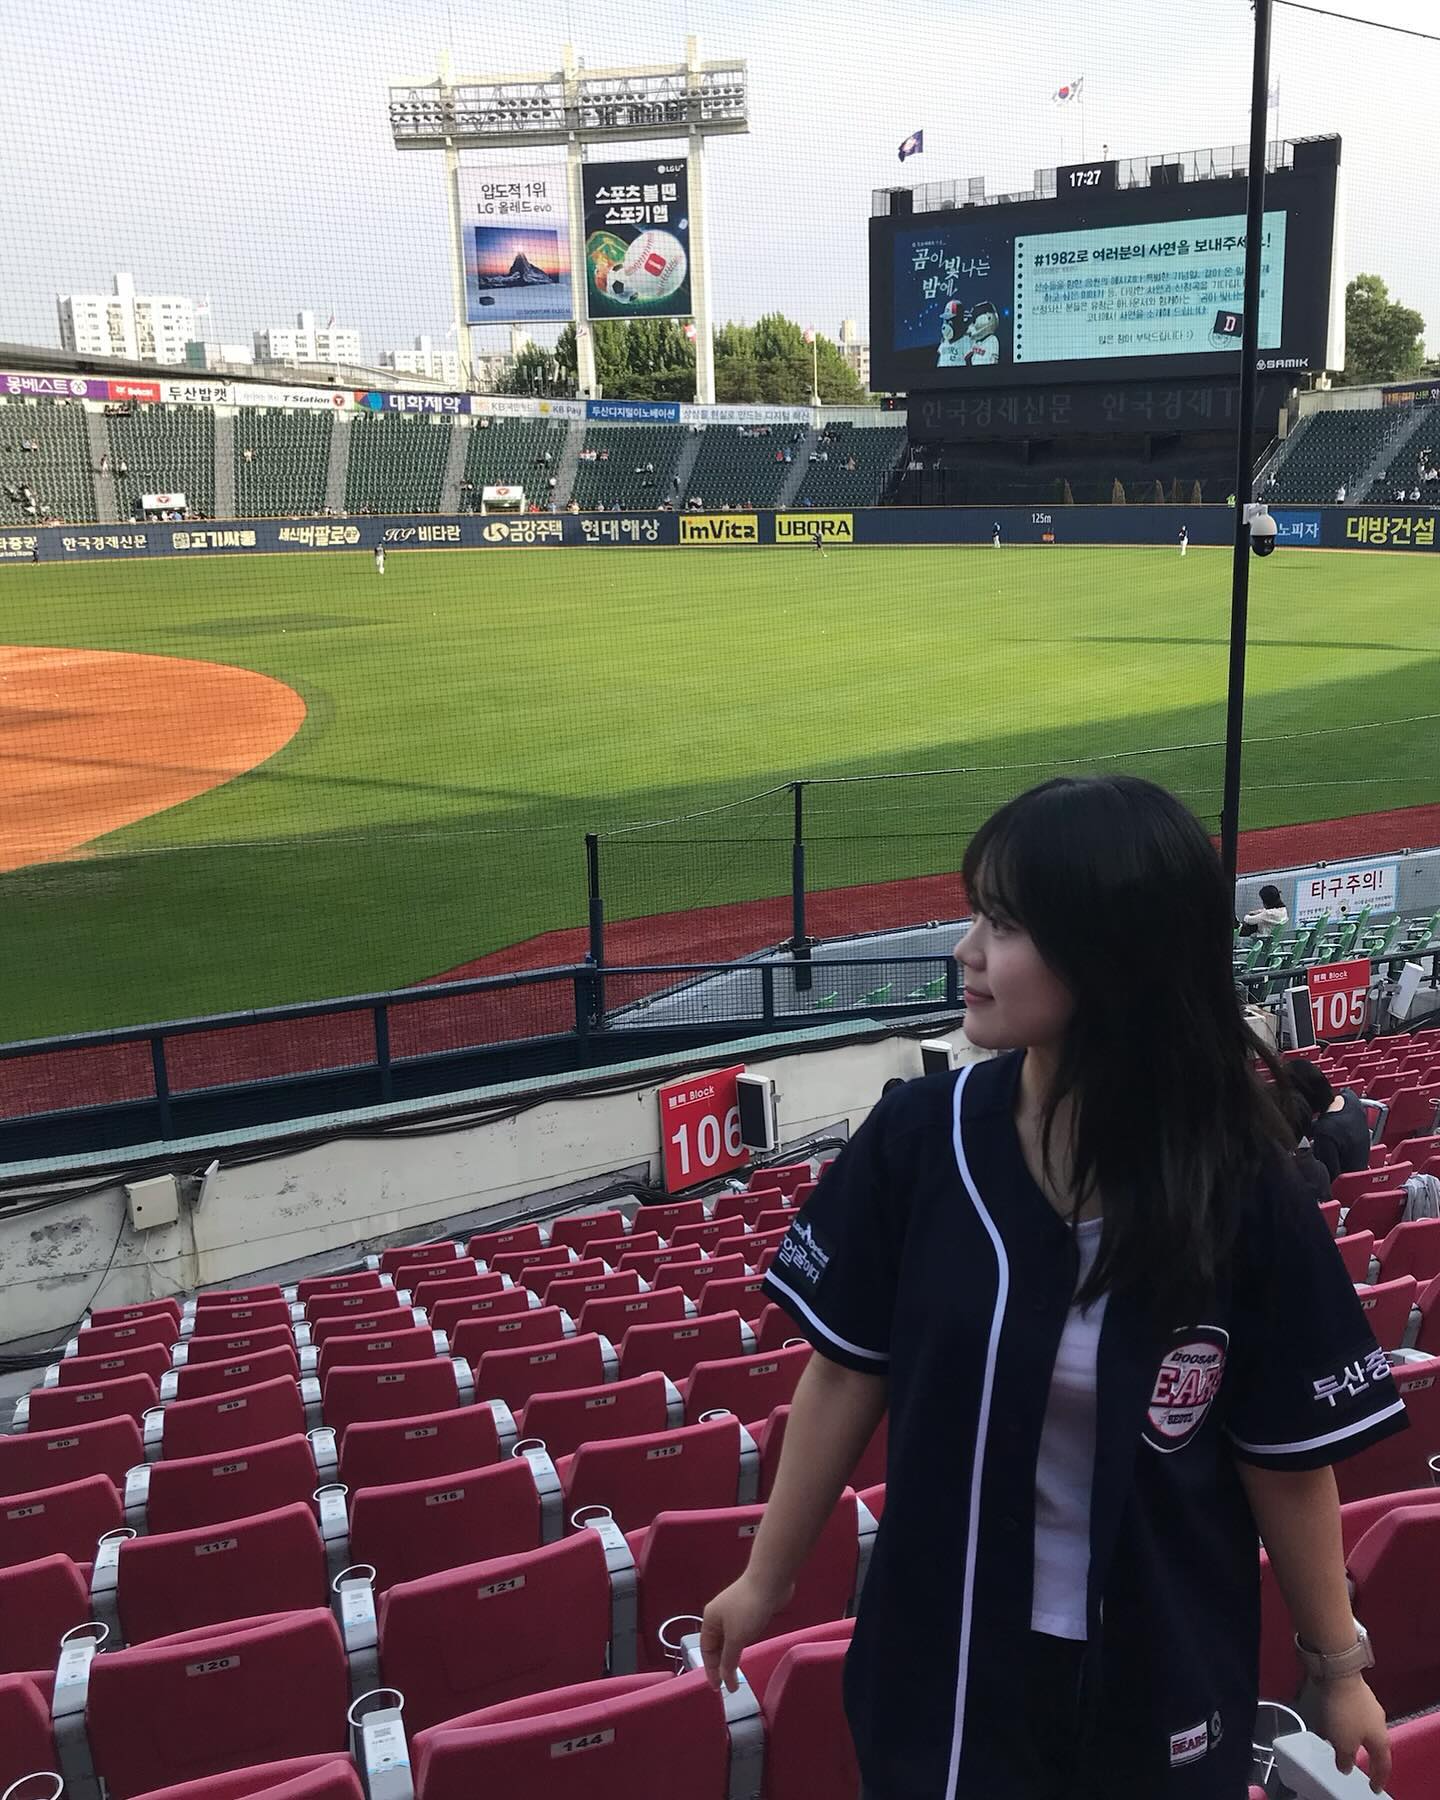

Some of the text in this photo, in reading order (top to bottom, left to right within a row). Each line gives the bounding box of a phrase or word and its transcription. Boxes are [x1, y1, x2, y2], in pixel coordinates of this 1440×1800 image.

[1069, 169, 1101, 188] 17:27
[481, 182, 546, 200] 압도적 1위
[595, 185, 641, 204] 스포츠
[477, 203, 494, 214] LG
[498, 201, 533, 215] 올레드
[605, 204, 669, 225] 스포키 앱
[1034, 249, 1089, 267] #1982로
[1092, 244, 1145, 262] 여러분의
[1149, 239, 1190, 257] 사연을
[912, 248, 990, 280] 곰이 빛나는
[922, 276, 957, 299] 밤에
[1223, 316, 1236, 332] D
[1266, 358, 1309, 369] SAMIK
[6, 376, 70, 395] 몽베스트
[168, 385, 228, 402] 두산밥캣
[283, 394, 290, 402] T
[292, 394, 330, 404] Station
[389, 393, 461, 413] 대화제약
[921, 393, 1072, 427] 한국경제신문
[1032, 513, 1052, 524] 125m
[418, 525, 461, 542] 비타란
[510, 520, 563, 542] 금강주택
[581, 519, 660, 541] 현대해상
[778, 520, 851, 536] UBORA
[1278, 523, 1319, 538] 노피자
[1346, 516, 1435, 545] 대방건설
[62, 534, 147, 551] 한국경제신문
[1311, 870, 1383, 899] 타구주의!
[1329, 970, 1348, 980] Block
[1312, 988, 1366, 1031] 105
[689, 1085, 714, 1100] Block
[672, 1105, 743, 1174] 106
[434, 1491, 457, 1503] 116
[202, 1541, 230, 1552] 117
[487, 1579, 516, 1594] 121
[196, 1660, 230, 1673] 120
[562, 1733, 604, 1753] 144
